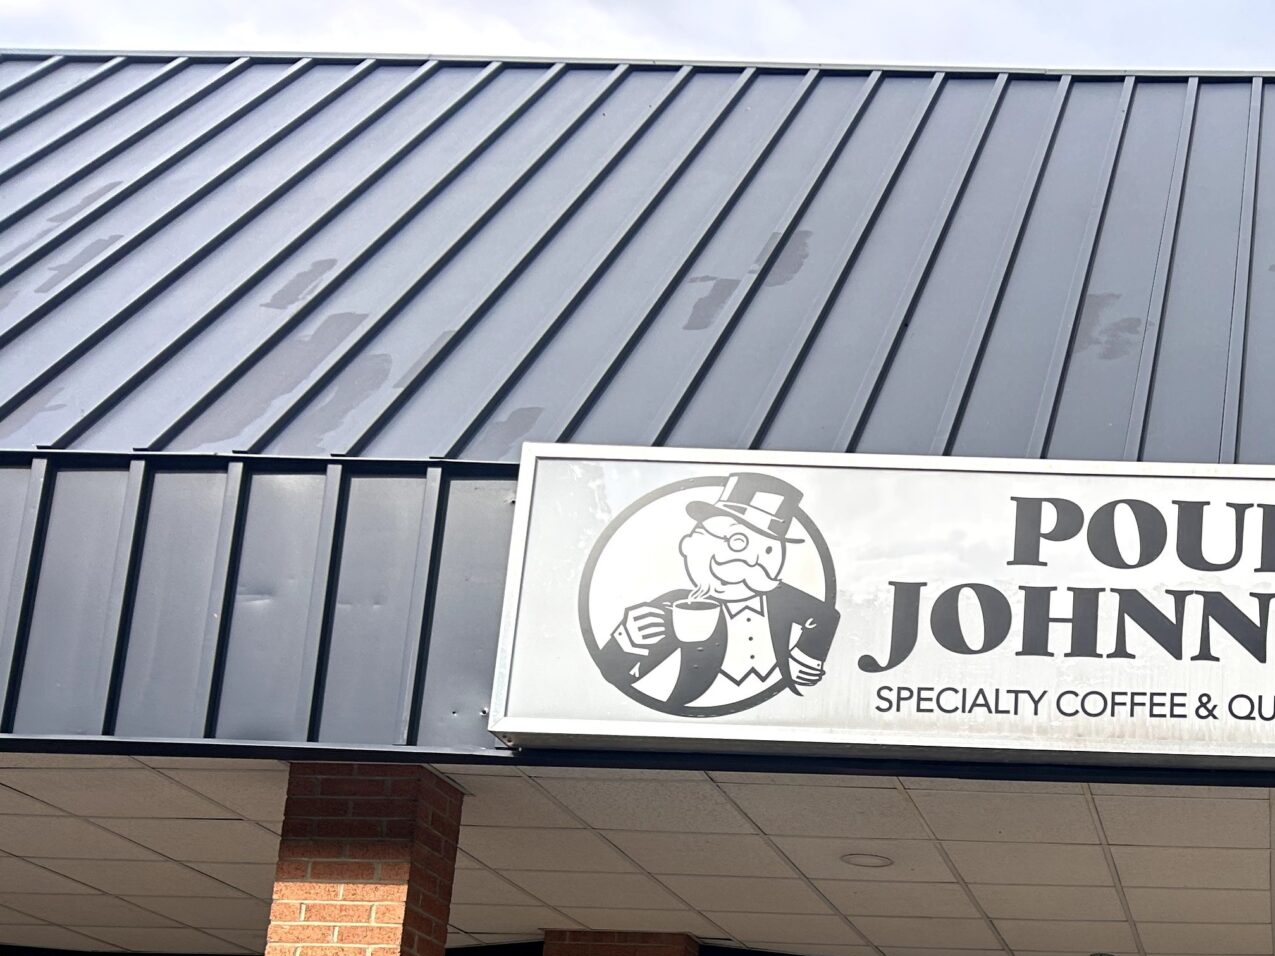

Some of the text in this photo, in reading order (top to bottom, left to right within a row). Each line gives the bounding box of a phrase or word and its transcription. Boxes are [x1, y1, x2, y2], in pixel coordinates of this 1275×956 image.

[875, 686, 1048, 716] SPECIALTY
[1056, 690, 1188, 719] COFFEE
[1194, 693, 1219, 719] &
